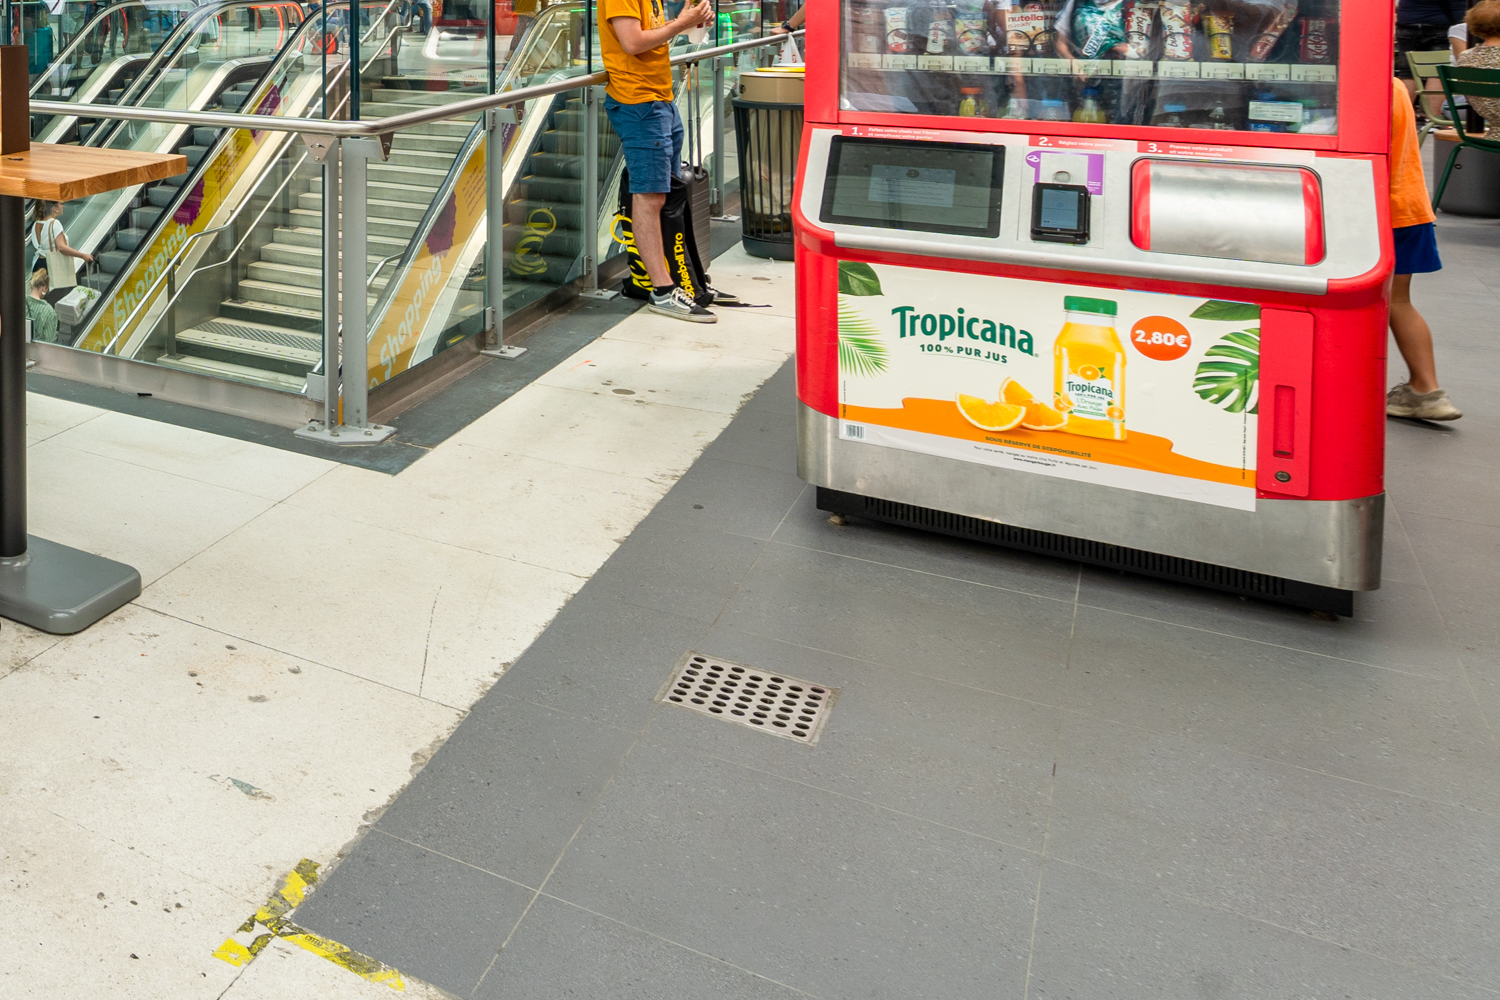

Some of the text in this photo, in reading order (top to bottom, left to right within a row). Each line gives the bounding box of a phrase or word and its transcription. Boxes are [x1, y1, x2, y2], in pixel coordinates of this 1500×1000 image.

[1007, 12, 1044, 22] nutella
[1136, 16, 1147, 42] bueno
[1167, 24, 1178, 48] bueno
[851, 126, 863, 136] 1.
[1038, 136, 1053, 147] 2.
[1058, 139, 1080, 147] Réglez
[1147, 143, 1163, 153] 3.
[673, 232, 686, 253] Pro
[114, 223, 187, 326] Shopping
[380, 256, 442, 381] Shopping
[891, 305, 1036, 357] Tropicana
[1134, 329, 1188, 347] 2,80€
[956, 345, 1008, 364] PUR JUS
[1066, 381, 1115, 400] Tropicana
[1003, 438, 1031, 448] RÉSERVE
[1041, 445, 1092, 458] DISPONIBILITÉ
